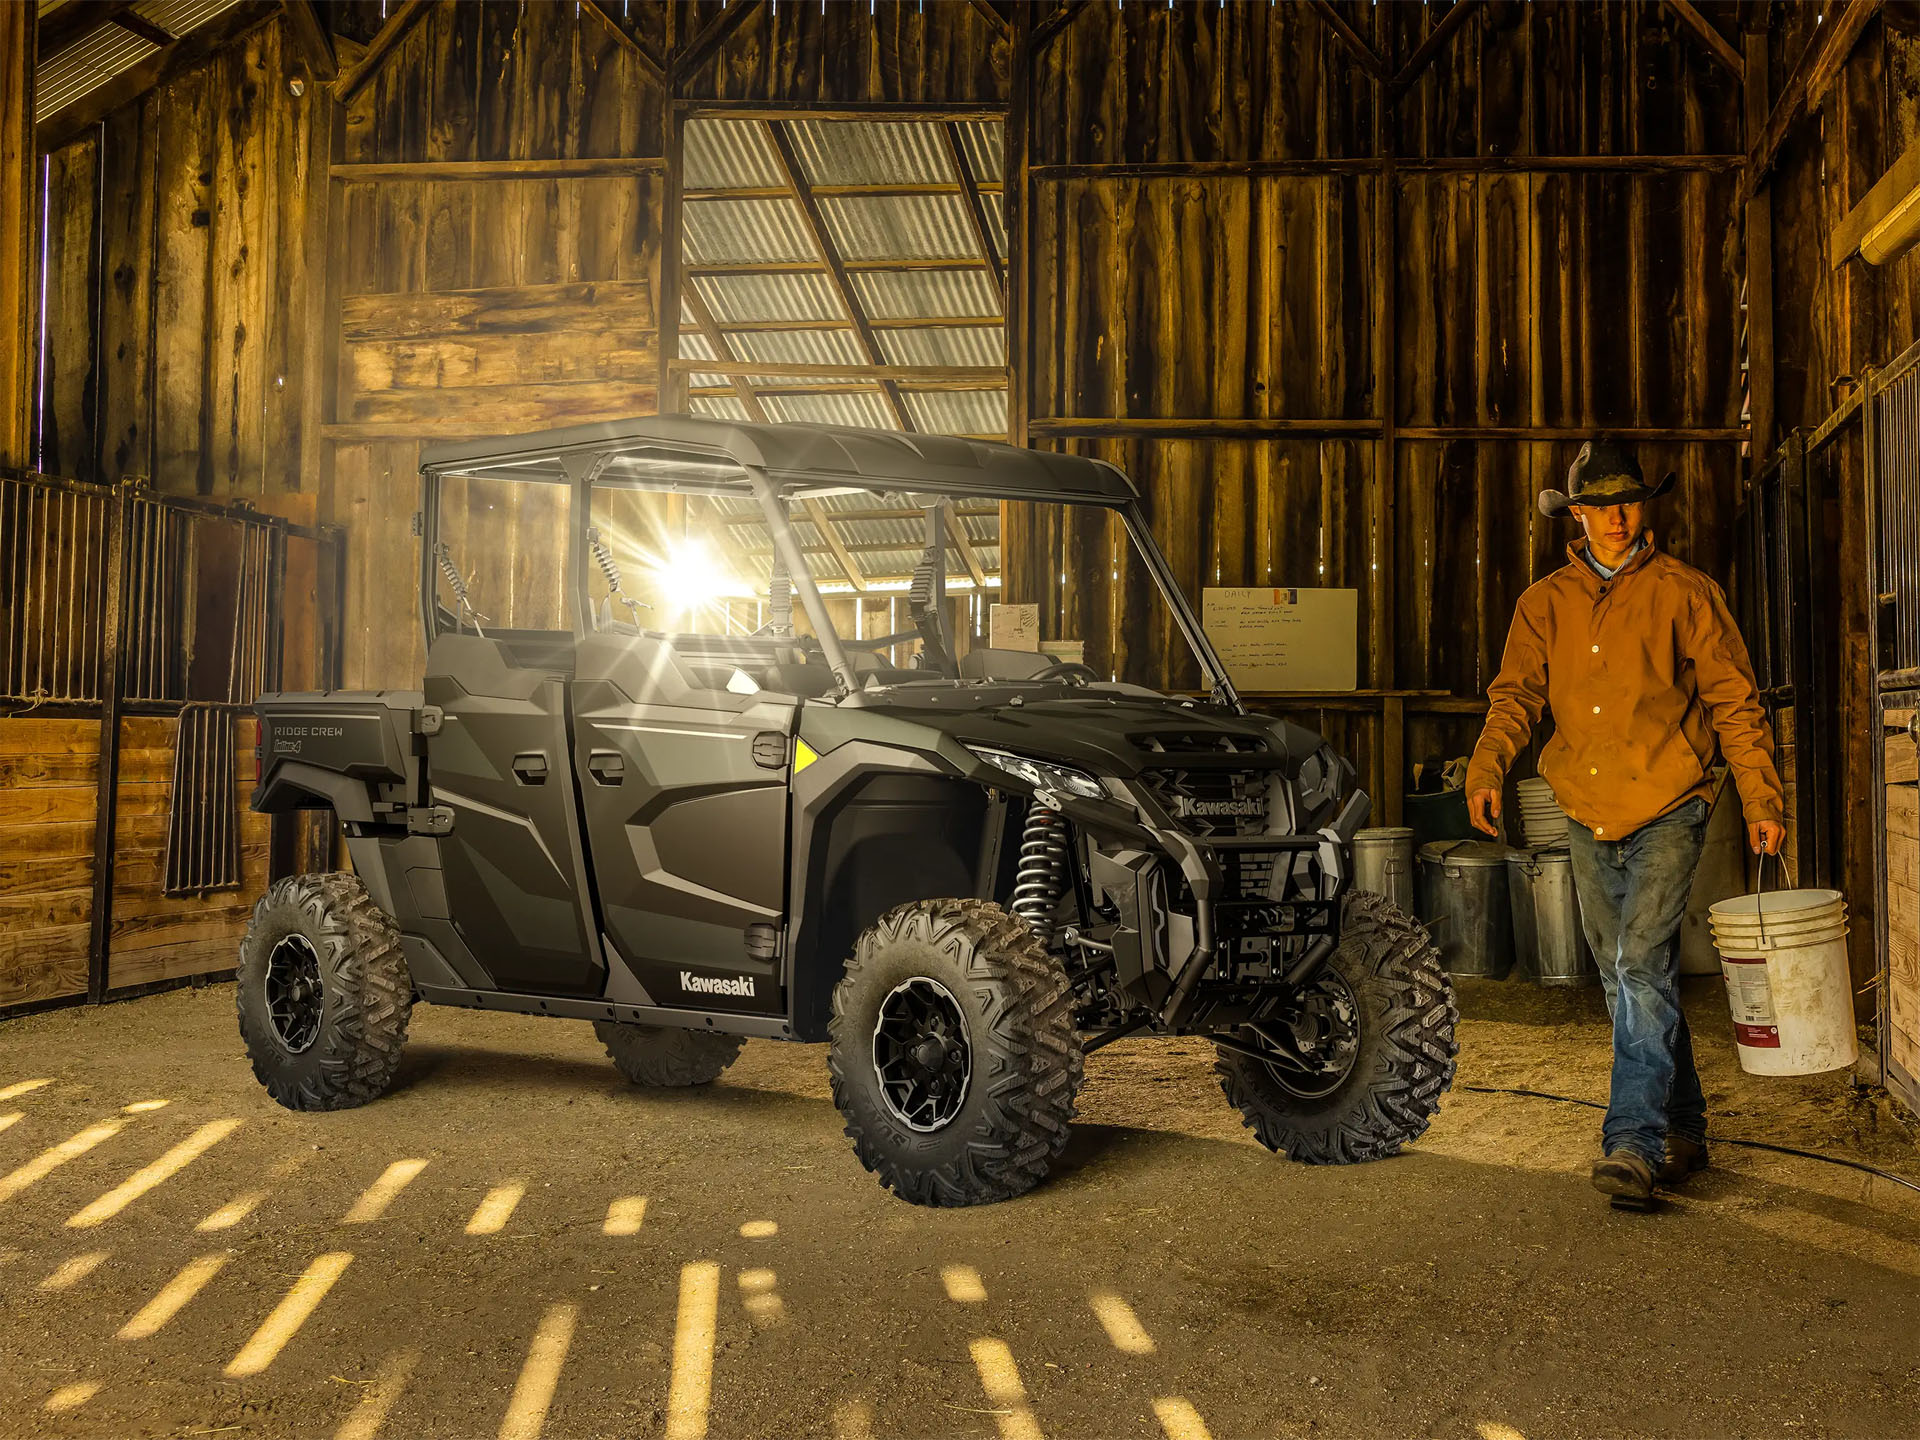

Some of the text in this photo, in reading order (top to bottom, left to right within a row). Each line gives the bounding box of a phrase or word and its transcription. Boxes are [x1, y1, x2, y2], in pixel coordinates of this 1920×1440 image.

[1224, 590, 1251, 599] DAILY
[274, 726, 343, 737] RIDGE CREW
[1183, 798, 1262, 816] Kawasaki
[680, 971, 755, 997] Kawasaki
